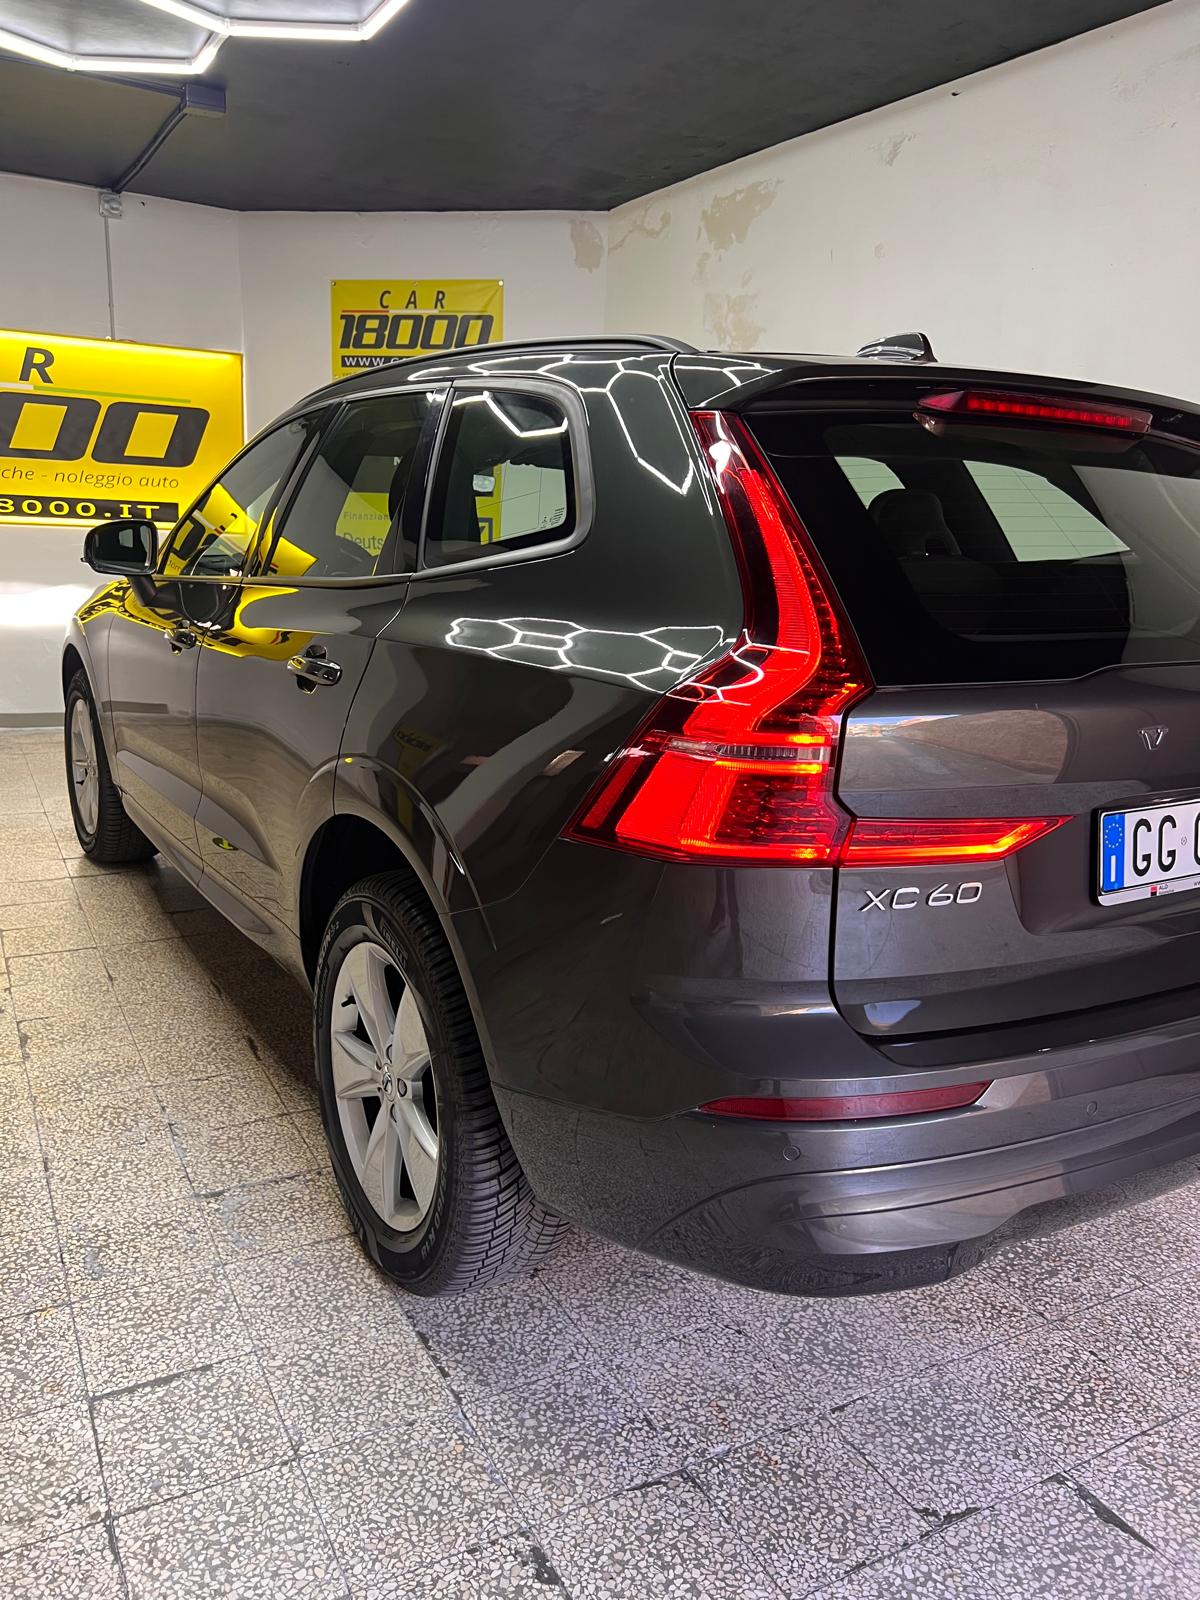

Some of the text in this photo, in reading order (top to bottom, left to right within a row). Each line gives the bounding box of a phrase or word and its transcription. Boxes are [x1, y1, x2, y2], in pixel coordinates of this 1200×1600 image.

[339, 314, 495, 350] 18000
[54, 470, 133, 489] noleggio
[139, 476, 179, 489] auto
